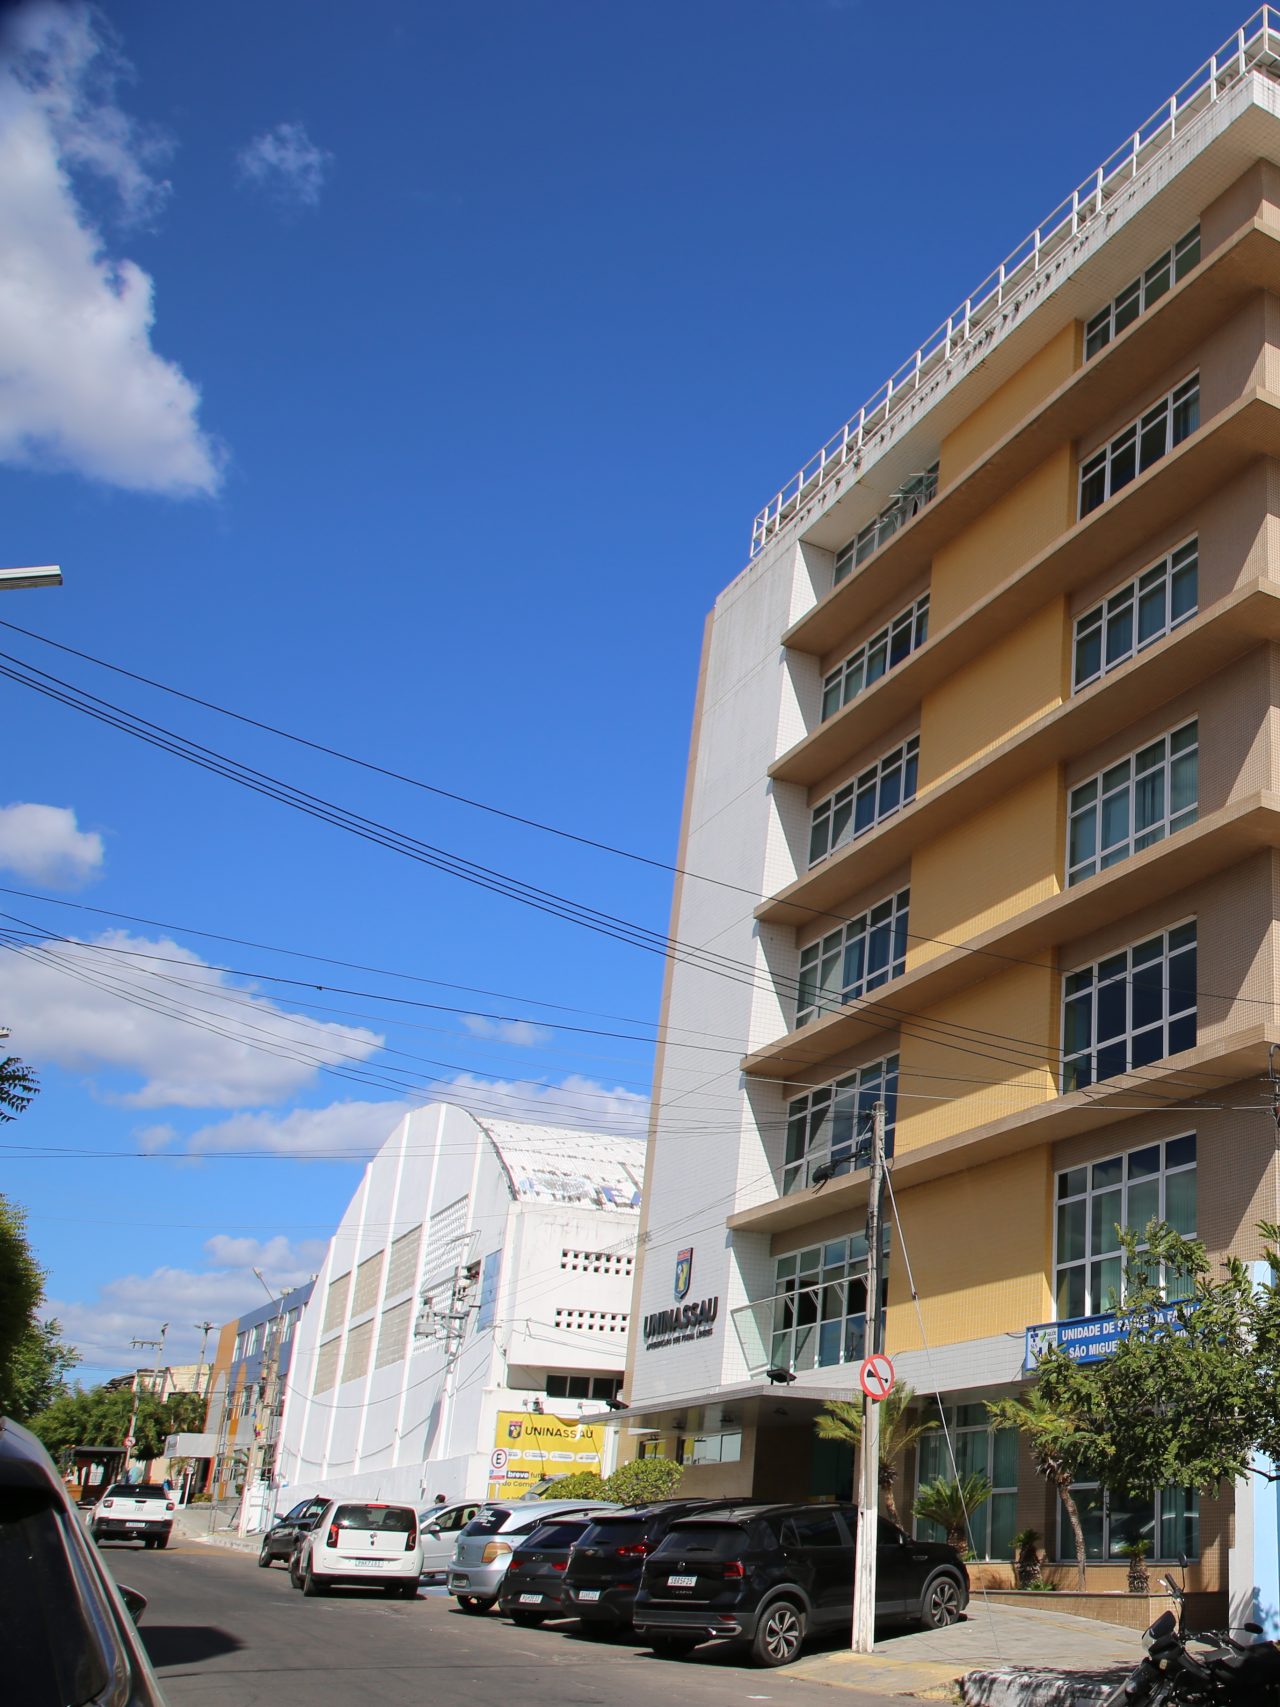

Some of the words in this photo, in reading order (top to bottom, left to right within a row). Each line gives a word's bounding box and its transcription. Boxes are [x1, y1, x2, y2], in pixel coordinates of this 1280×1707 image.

[644, 1296, 719, 1339] UNINASSAU
[1061, 1324, 1101, 1341] UNIDADE
[1102, 1321, 1115, 1335] DE
[1069, 1344, 1087, 1358] SÃO
[1088, 1340, 1120, 1356] MIGUE
[525, 1426, 593, 1439] UNINASSAU
[495, 1453, 502, 1465] E
[507, 1471, 529, 1479] breve
